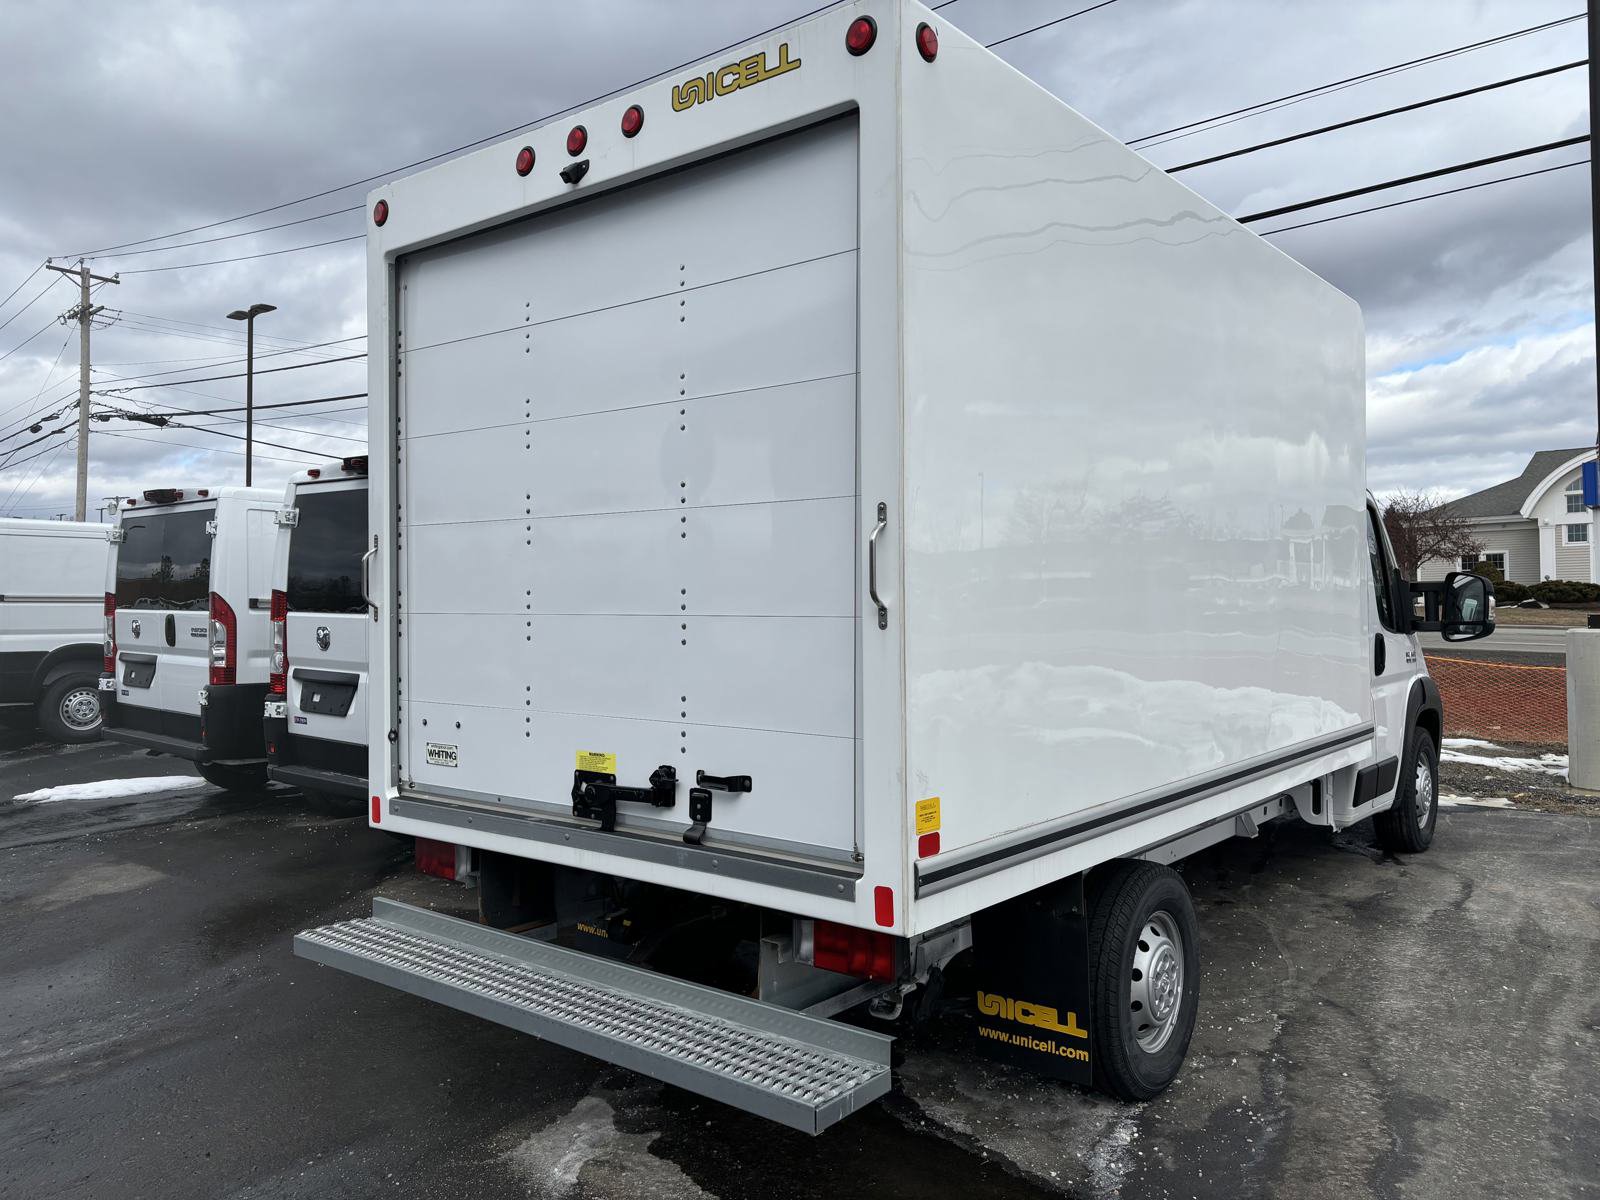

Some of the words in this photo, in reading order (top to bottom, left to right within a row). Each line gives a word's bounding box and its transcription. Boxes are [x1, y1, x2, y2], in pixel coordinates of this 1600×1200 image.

[672, 43, 801, 112] UNICELL
[428, 749, 457, 760] WHITING
[977, 991, 1087, 1038] UNICELL
[979, 1026, 1088, 1061] www.unicell.com
